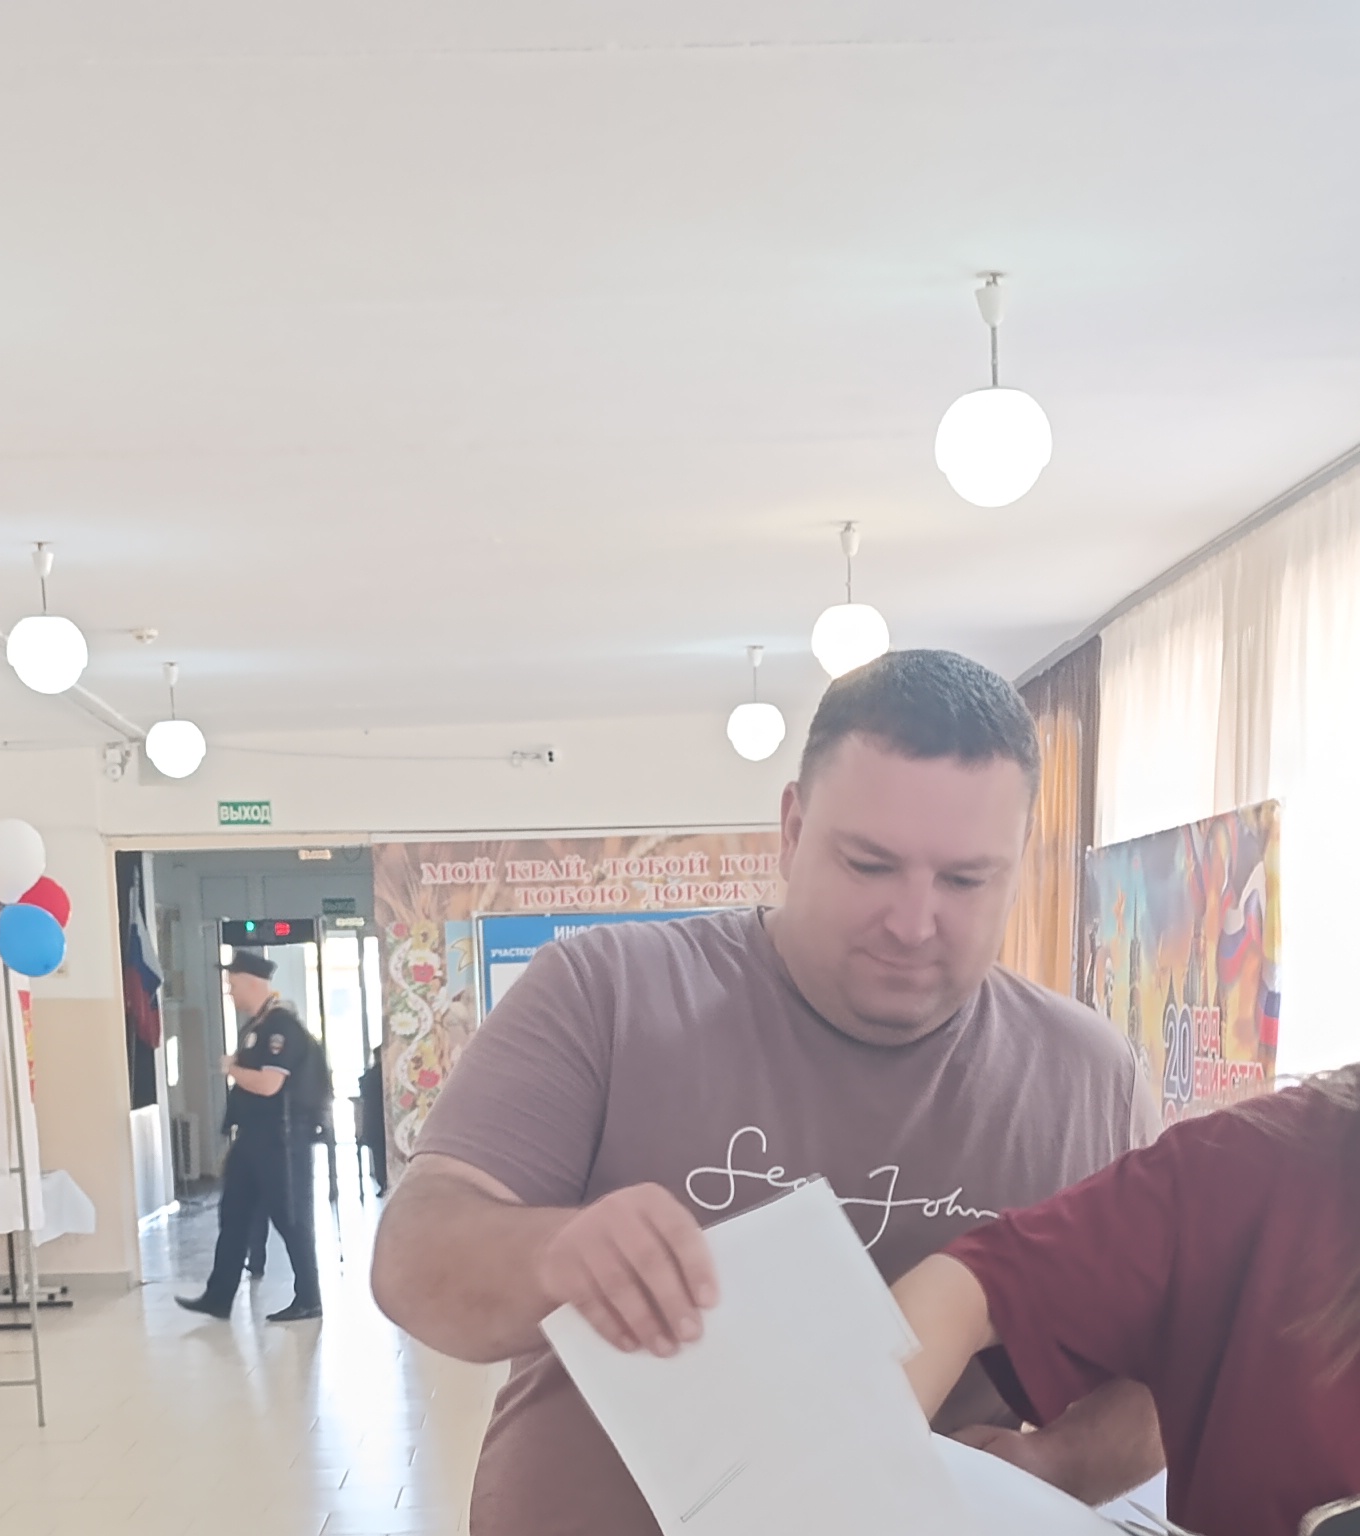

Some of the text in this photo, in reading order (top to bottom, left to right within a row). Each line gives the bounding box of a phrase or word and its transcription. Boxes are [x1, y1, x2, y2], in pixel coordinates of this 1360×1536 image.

[219, 805, 271, 823] ВЫХОД
[420, 852, 780, 884] МОЙ КРАЙ, ТОБОЙ ГОР
[515, 880, 778, 909] ТОБОЮ ДОРОЖУ!
[554, 925, 590, 941] ИНФ
[1192, 1006, 1221, 1060] ГОД
[839, 1165, 1001, 1252] John
